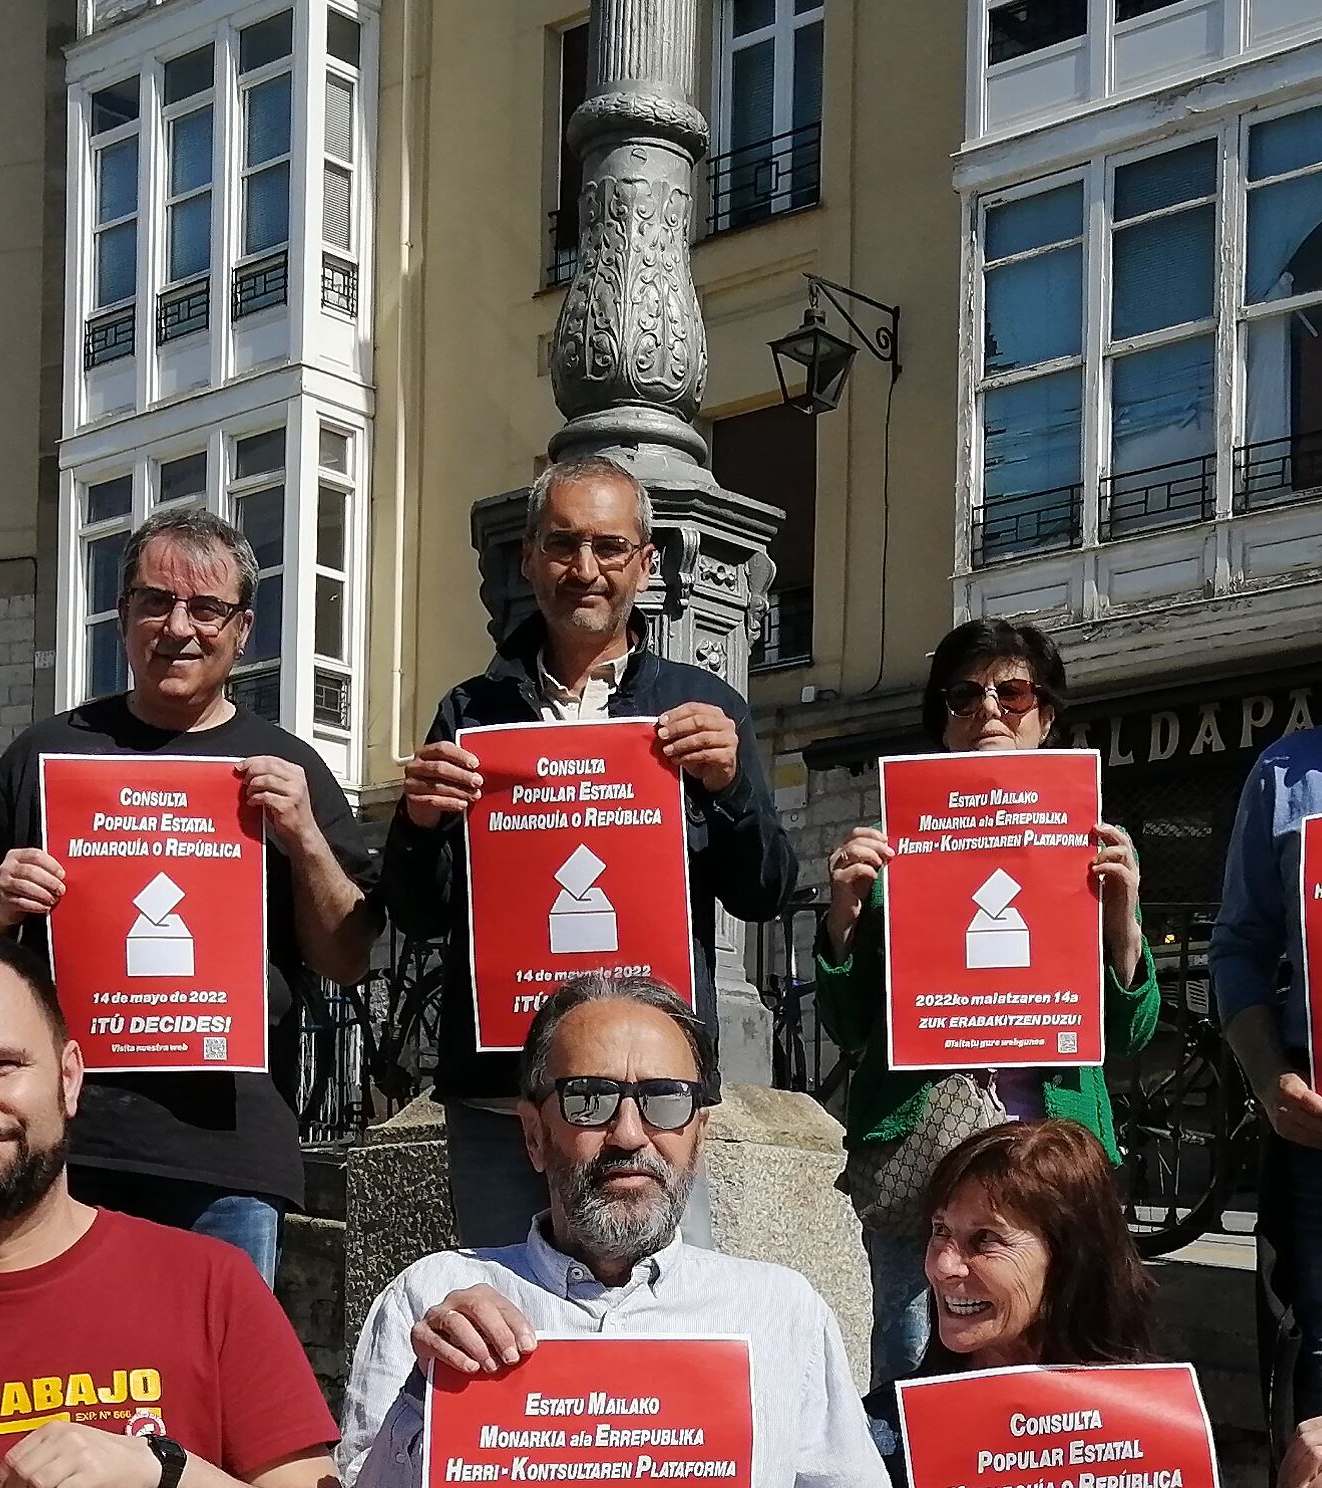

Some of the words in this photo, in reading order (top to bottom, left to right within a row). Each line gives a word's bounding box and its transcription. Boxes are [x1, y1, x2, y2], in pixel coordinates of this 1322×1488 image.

[113, 1410, 131, 1420] 666
[525, 1393, 584, 1416] ESTATU
[588, 1392, 659, 1416] MAILAKO
[1011, 1410, 1102, 1436] CONSULTA
[480, 1425, 566, 1448] MONARKIA
[595, 1424, 704, 1447] ERREPUBLIKA
[635, 1455, 735, 1478] PLATAFORMA
[978, 1448, 1063, 1473] POPULAR
[1070, 1440, 1143, 1464] ESTATAL
